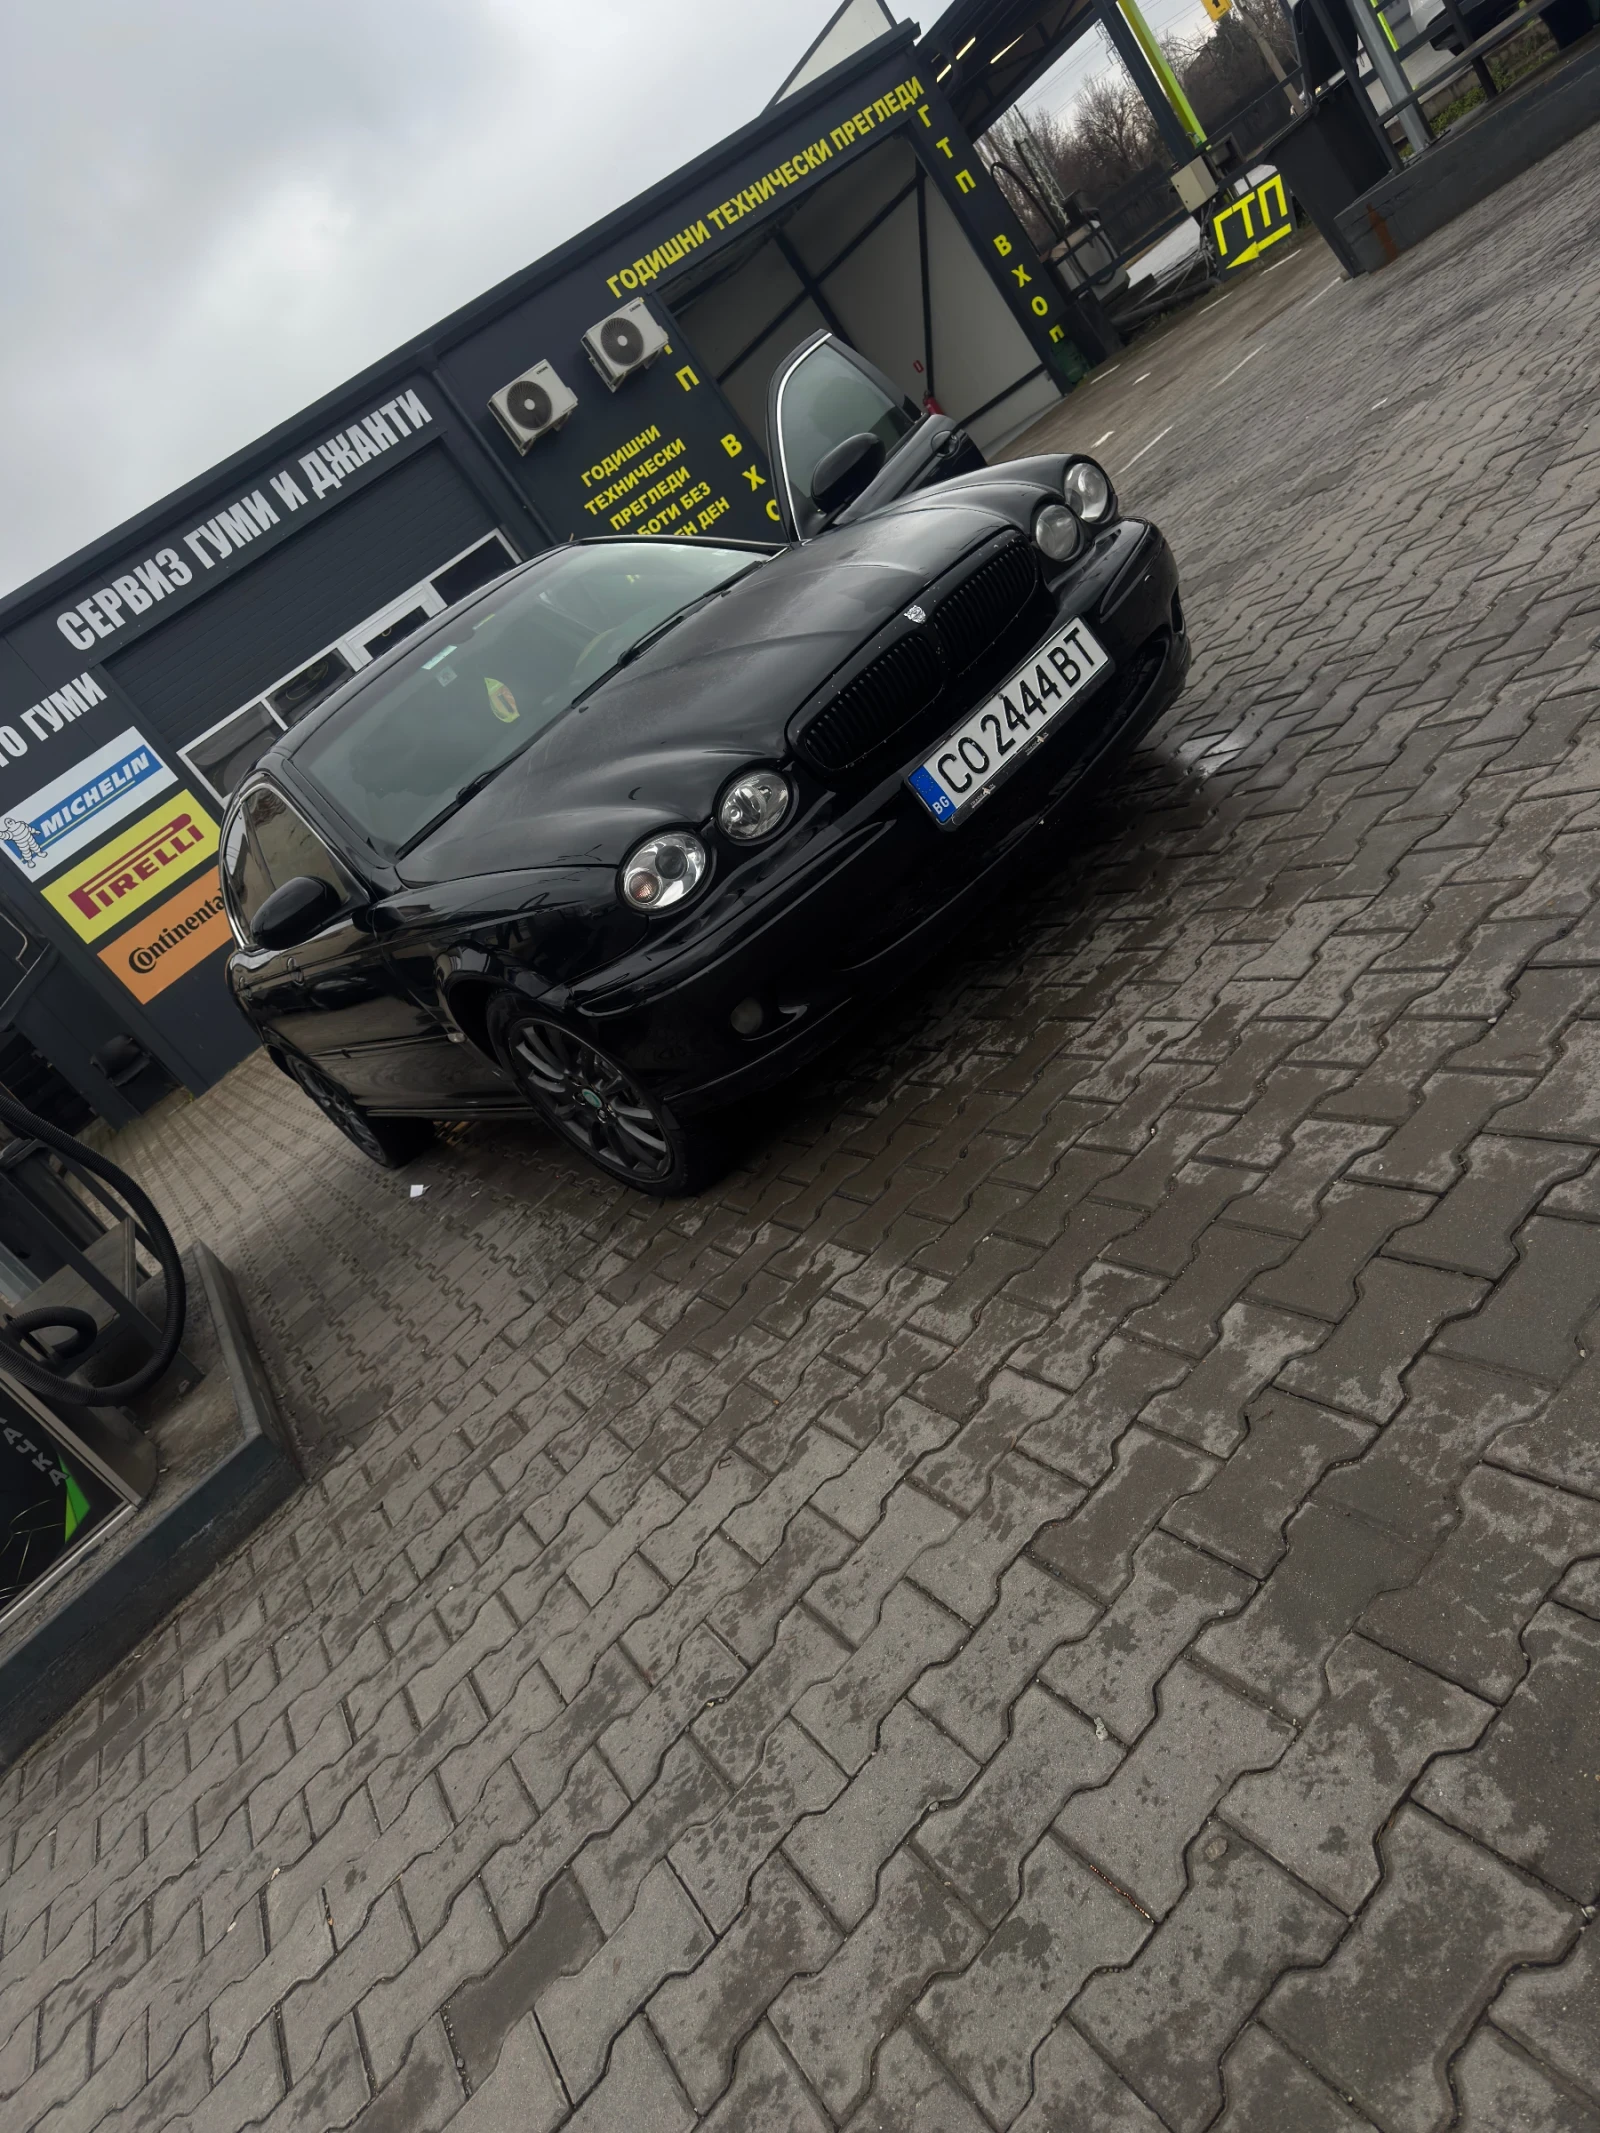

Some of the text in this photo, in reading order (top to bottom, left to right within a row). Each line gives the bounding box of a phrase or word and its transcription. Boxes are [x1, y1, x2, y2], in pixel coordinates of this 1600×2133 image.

[606, 75, 925, 298] ГОДИШНИ ТЕХНИЧЕСКИ ПРЕГЛЕДИ
[1213, 173, 1288, 256] ГТП
[581, 424, 661, 488] ГОДИШНИ
[584, 438, 687, 516] ТЕХНИЧЕСКИ
[720, 433, 781, 521] ВХО
[56, 388, 433, 651] СЕРВИЗ ГУМИ И ДЖАНТИ
[609, 466, 691, 531] ПРЕГЛЕДИ
[637, 481, 711, 535] БОТИ БЕЗ
[697, 496, 731, 531] ДЕН
[0, 672, 107, 768] О ГУМИ
[40, 752, 149, 837] MICHELIN
[932, 795, 950, 815] BG
[68, 813, 205, 920] PIRELLI
